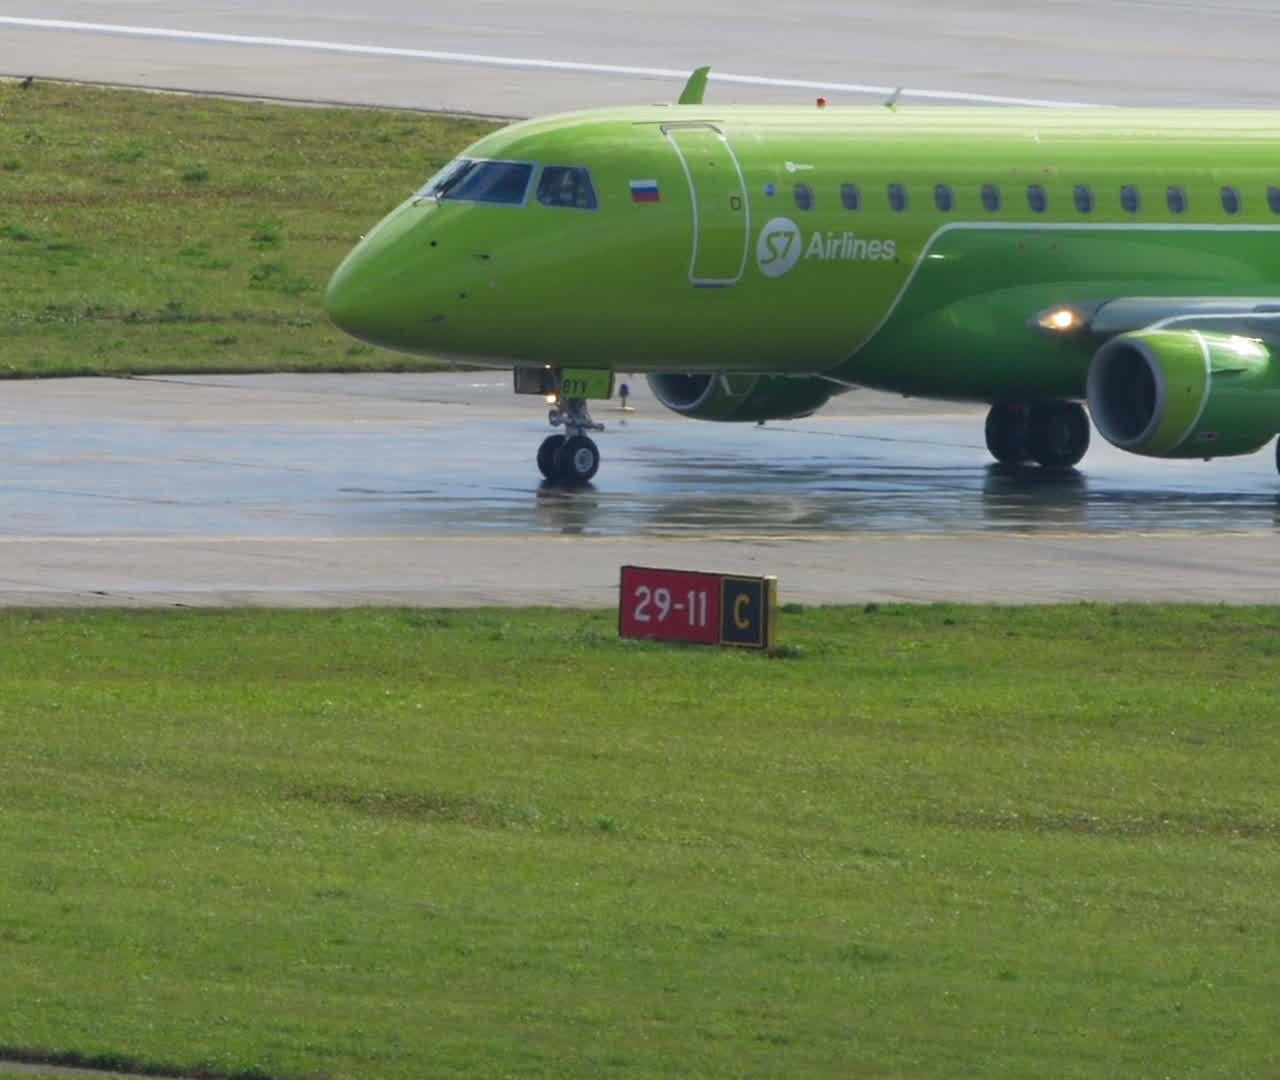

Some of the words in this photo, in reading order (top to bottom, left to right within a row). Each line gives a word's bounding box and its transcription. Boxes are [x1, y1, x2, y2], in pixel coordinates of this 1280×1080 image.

[759, 231, 797, 265] S7
[805, 231, 896, 260] Airlines
[634, 585, 708, 627] 29-11
[733, 592, 751, 630] C
